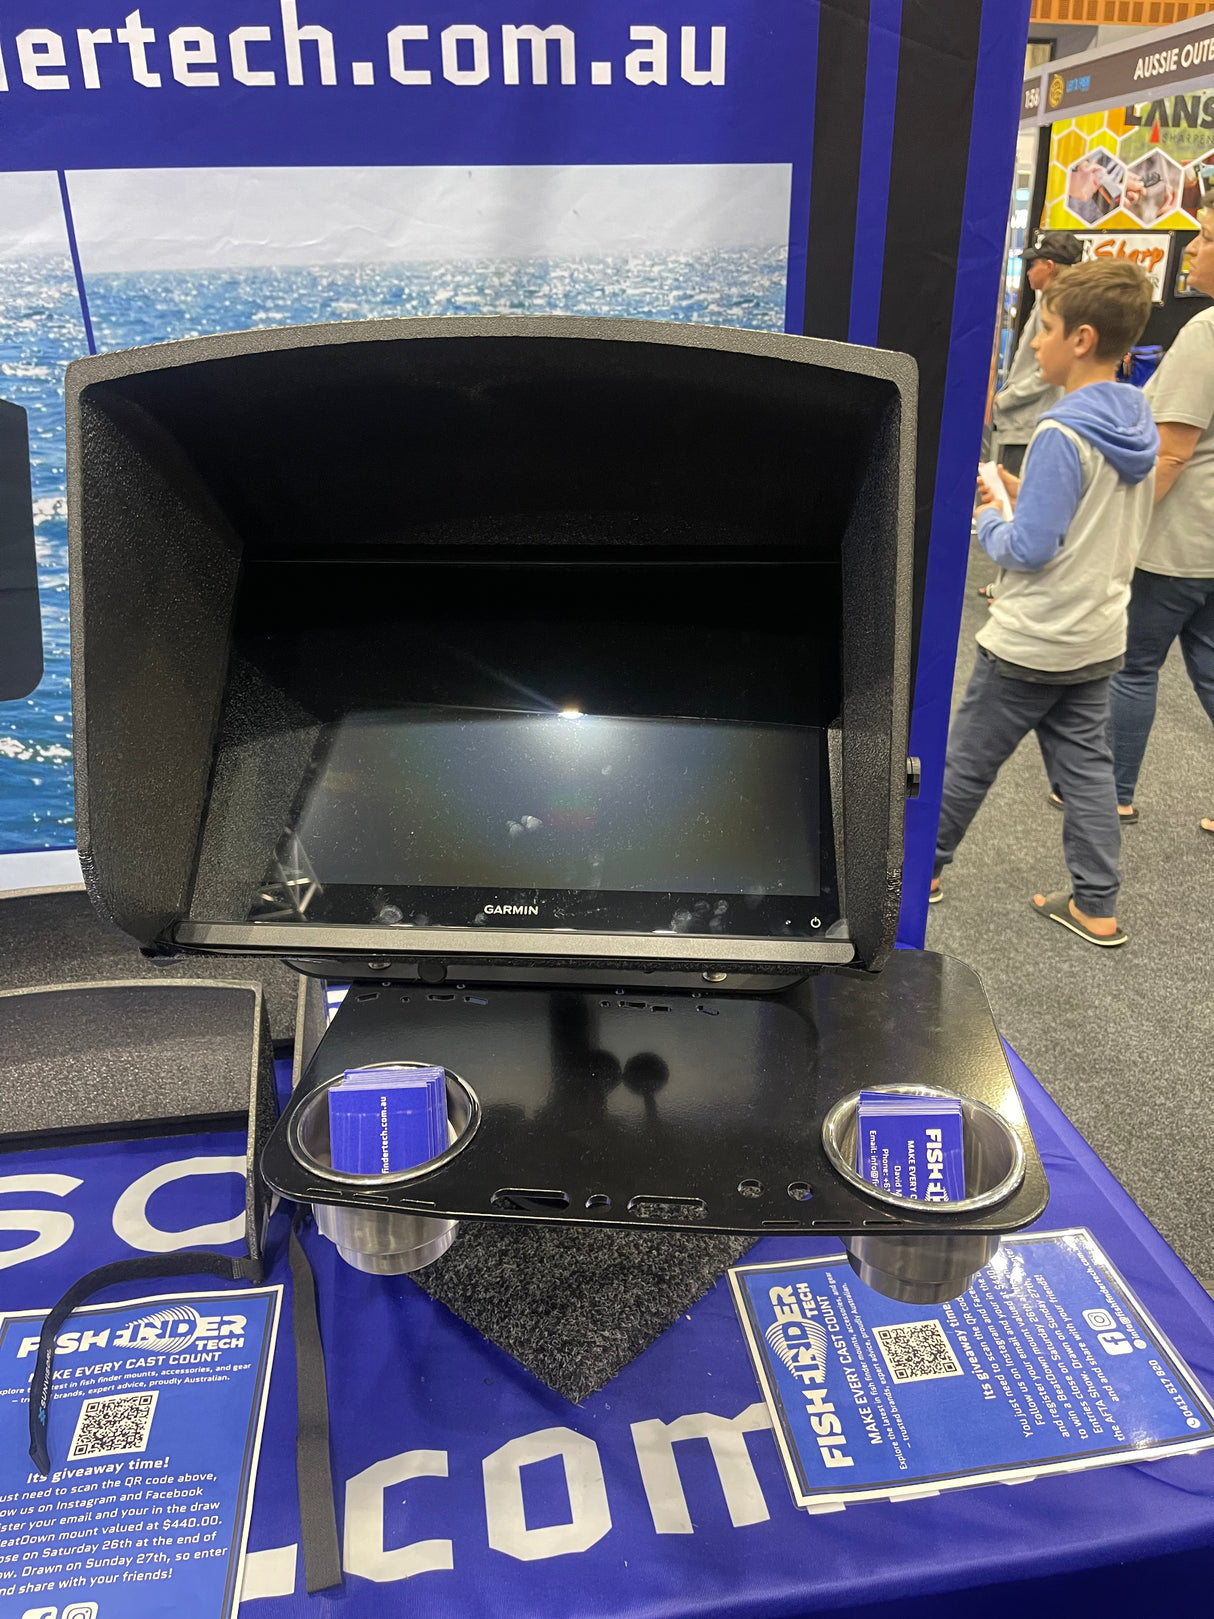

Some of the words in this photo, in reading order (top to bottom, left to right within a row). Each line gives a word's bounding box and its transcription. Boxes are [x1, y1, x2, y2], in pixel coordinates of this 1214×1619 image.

[0, 0, 727, 92] ertech.com.au
[1133, 47, 1180, 81] AUSSIE
[1094, 238, 1165, 272] Sharp
[483, 904, 539, 916] GARMIN
[869, 1130, 877, 1154] Email:
[907, 1140, 917, 1165] MAKE
[882, 1148, 890, 1176] Phone:
[925, 1128, 944, 1180] FISH
[894, 1165, 902, 1187] David
[909, 1166, 918, 1191] EVERY
[825, 1272, 836, 1284] gear
[973, 1278, 989, 1291] the
[1018, 1278, 1040, 1299] 27th,
[1033, 1274, 1058, 1303] friends!
[795, 1282, 819, 1317] TECH
[829, 1285, 839, 1296] and
[985, 1292, 994, 1300] in
[816, 1296, 840, 1332] COUNT
[836, 1296, 854, 1333] accessories,
[942, 1301, 959, 1328] time
[963, 1312, 977, 1325] QR
[976, 1308, 992, 1323] and
[990, 1301, 1007, 1319] your
[1003, 1300, 1025, 1327] valued
[1018, 1302, 1039, 1323] 26th
[1032, 1300, 1058, 1329] Sunday
[1054, 1304, 1072, 1322] your
[972, 1326, 984, 1340] the
[998, 1320, 1014, 1335] and
[1055, 1330, 1066, 1341] on
[1066, 1323, 1082, 1341] with
[16, 1328, 111, 1358] FSH
[195, 1336, 244, 1351] TECH
[831, 1334, 852, 1364] CAST
[851, 1334, 864, 1361] mounts,
[980, 1341, 995, 1361] scan
[987, 1325, 1015, 1367] Instagram
[1008, 1336, 1027, 1359] email
[1021, 1328, 1043, 1355] mount
[1034, 1324, 1061, 1361] Saturday
[75, 1361, 123, 1377] EVERY
[125, 1356, 166, 1369] CAST
[169, 1352, 222, 1365] COUNT
[954, 1330, 990, 1380] giveaway
[1062, 1342, 1083, 1369] Drawn
[1078, 1342, 1097, 1365] share
[79, 1378, 95, 1386] fish
[97, 1374, 122, 1384] finder
[123, 1370, 158, 1379] mounts,
[159, 1366, 213, 1375] accessories,
[860, 1361, 873, 1381] finder
[991, 1363, 1001, 1373] to
[1010, 1368, 1021, 1379] on
[1023, 1361, 1041, 1381] your
[1037, 1356, 1068, 1401] BeatDown
[1058, 1362, 1069, 1373] on
[1091, 1367, 1108, 1383] and
[1148, 1360, 1166, 1377] 820
[53, 1390, 85, 1399] brands,
[88, 1385, 115, 1394] expert
[116, 1381, 147, 1390] advice,
[149, 1378, 182, 1387] proudly
[183, 1374, 230, 1383] Australian.
[843, 1367, 868, 1404] EVERY
[868, 1382, 878, 1396] fish
[981, 1383, 996, 1400] Its
[994, 1374, 1014, 1397] need
[1017, 1381, 1028, 1392] us
[1065, 1375, 1083, 1399] close
[1080, 1371, 1100, 1398] Show.
[1102, 1385, 1120, 1402] and
[1160, 1378, 1178, 1394] 517
[874, 1396, 882, 1404] in
[1008, 1399, 1027, 1417] just
[1024, 1394, 1046, 1425] Follow
[1034, 1382, 1060, 1418] register
[1095, 1399, 1116, 1423] AFTA
[1173, 1394, 1193, 1417] 0411
[858, 1406, 883, 1444] MAKE
[877, 1405, 891, 1426] latest
[1068, 1410, 1082, 1427] win
[1080, 1401, 1104, 1433] Entries
[800, 1387, 856, 1469] FISH
[886, 1427, 896, 1440] the
[1019, 1418, 1033, 1438] You
[1052, 1420, 1070, 1437] and
[1078, 1429, 1089, 1439] to
[1112, 1425, 1125, 1441] the
[27, 1473, 47, 1484] Its
[51, 1462, 124, 1483] giveaway
[128, 1456, 169, 1470] time!
[22, 1487, 52, 1500] need
[55, 1488, 67, 1496] to
[70, 1483, 98, 1494] scan
[102, 1480, 121, 1489] the
[124, 1476, 142, 1488] QR
[145, 1475, 174, 1485] code
[177, 1473, 217, 1483] above,
[20, 1506, 35, 1515] us
[38, 1504, 53, 1513] on
[56, 1495, 117, 1510] Instagram
[119, 1491, 143, 1501] and
[145, 1486, 203, 1499] Facebook
[28, 1518, 57, 1531] your
[59, 1512, 92, 1525] email
[95, 1508, 118, 1520] and
[121, 1508, 149, 1519] your
[152, 1505, 163, 1514] in
[167, 1504, 187, 1513] the
[190, 1502, 220, 1512] draw
[0, 1534, 55, 1548] eatDown
[58, 1527, 99, 1540] mount
[102, 1521, 143, 1534] valued
[146, 1521, 159, 1531] at
[162, 1515, 222, 1531] $440.00.
[22, 1552, 39, 1560] on
[42, 1543, 99, 1558] Saturday
[102, 1538, 132, 1550] 26th
[135, 1538, 149, 1547] at
[152, 1536, 173, 1546] the
[176, 1533, 200, 1544] end
[203, 1531, 217, 1542] of
[22, 1564, 63, 1577] Drawn
[66, 1562, 82, 1571] on
[85, 1555, 133, 1569] Sunday
[136, 1552, 171, 1564] 27th,
[175, 1552, 190, 1561] so
[194, 1548, 228, 1559] enter
[18, 1582, 55, 1594] share
[59, 1576, 86, 1589] with
[90, 1574, 119, 1587] your
[122, 1568, 173, 1582] friends!
